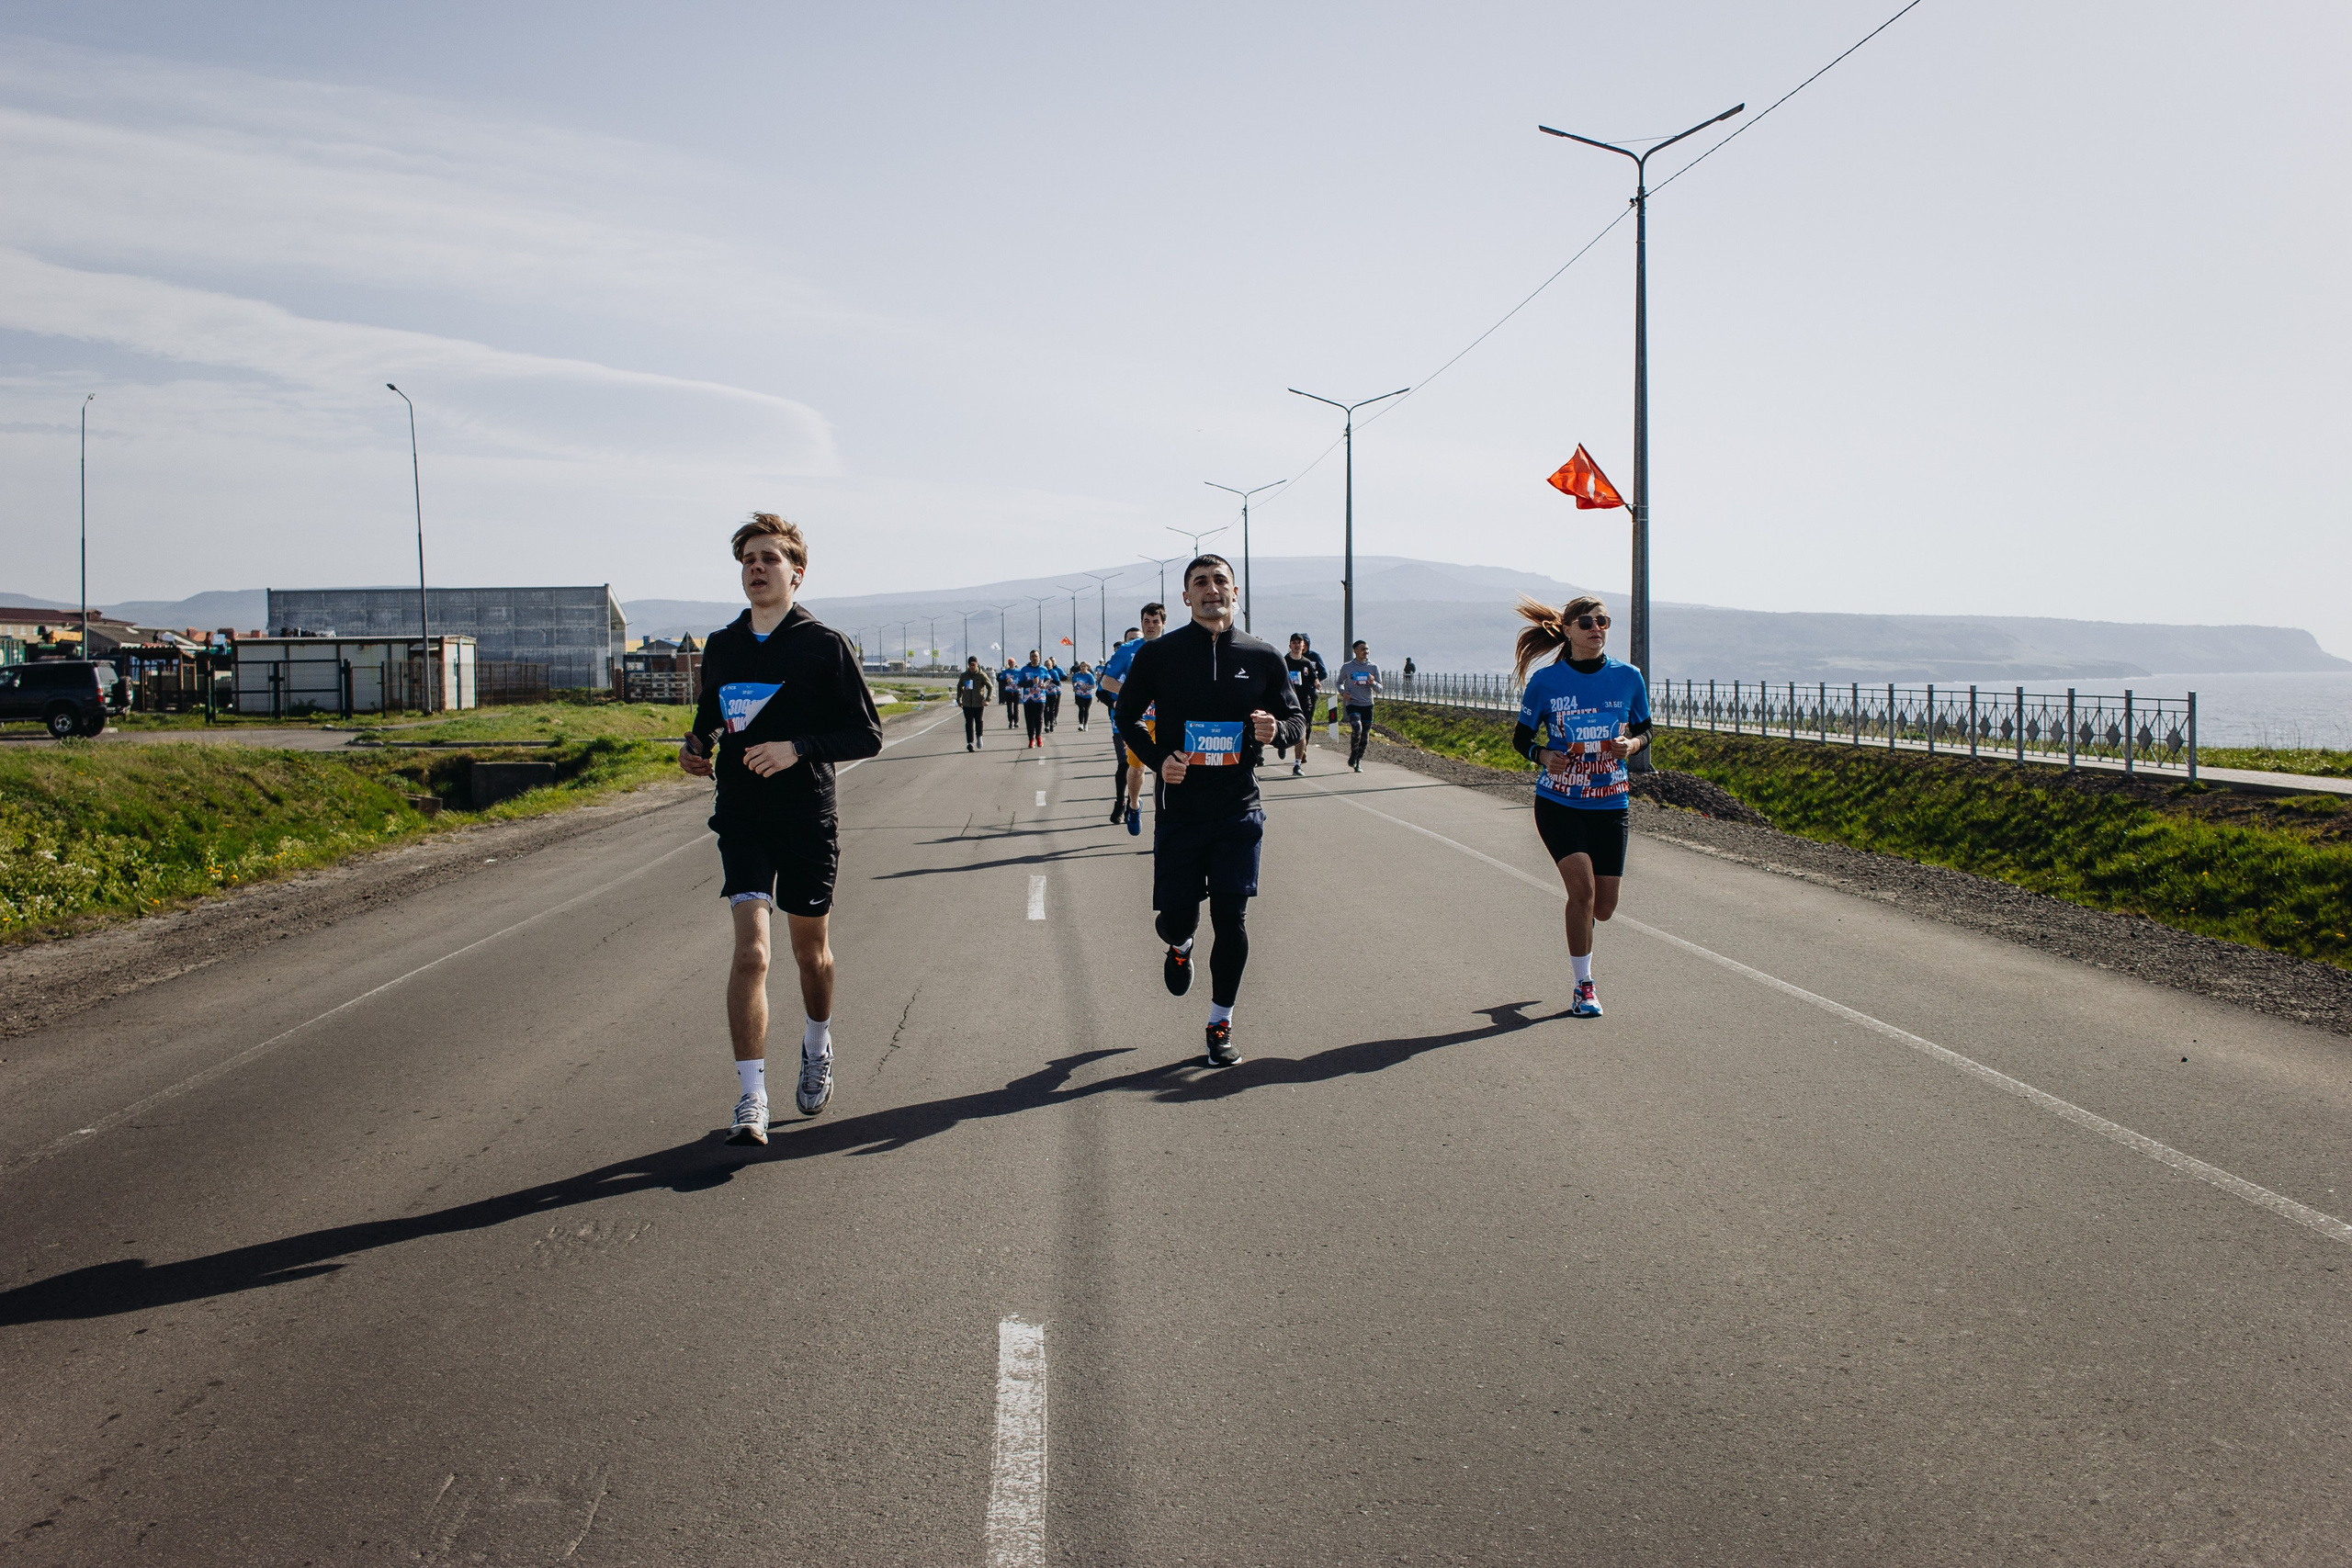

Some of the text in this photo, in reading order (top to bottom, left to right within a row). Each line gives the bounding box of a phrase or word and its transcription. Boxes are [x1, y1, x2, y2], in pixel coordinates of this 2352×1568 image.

[728, 698, 755, 716] 300
[1549, 695, 1578, 712] 2024
[1576, 725, 1610, 740] 20025
[1197, 736, 1234, 751] 20006
[1584, 740, 1601, 753] 5KM
[1204, 752, 1224, 766] 5KM
